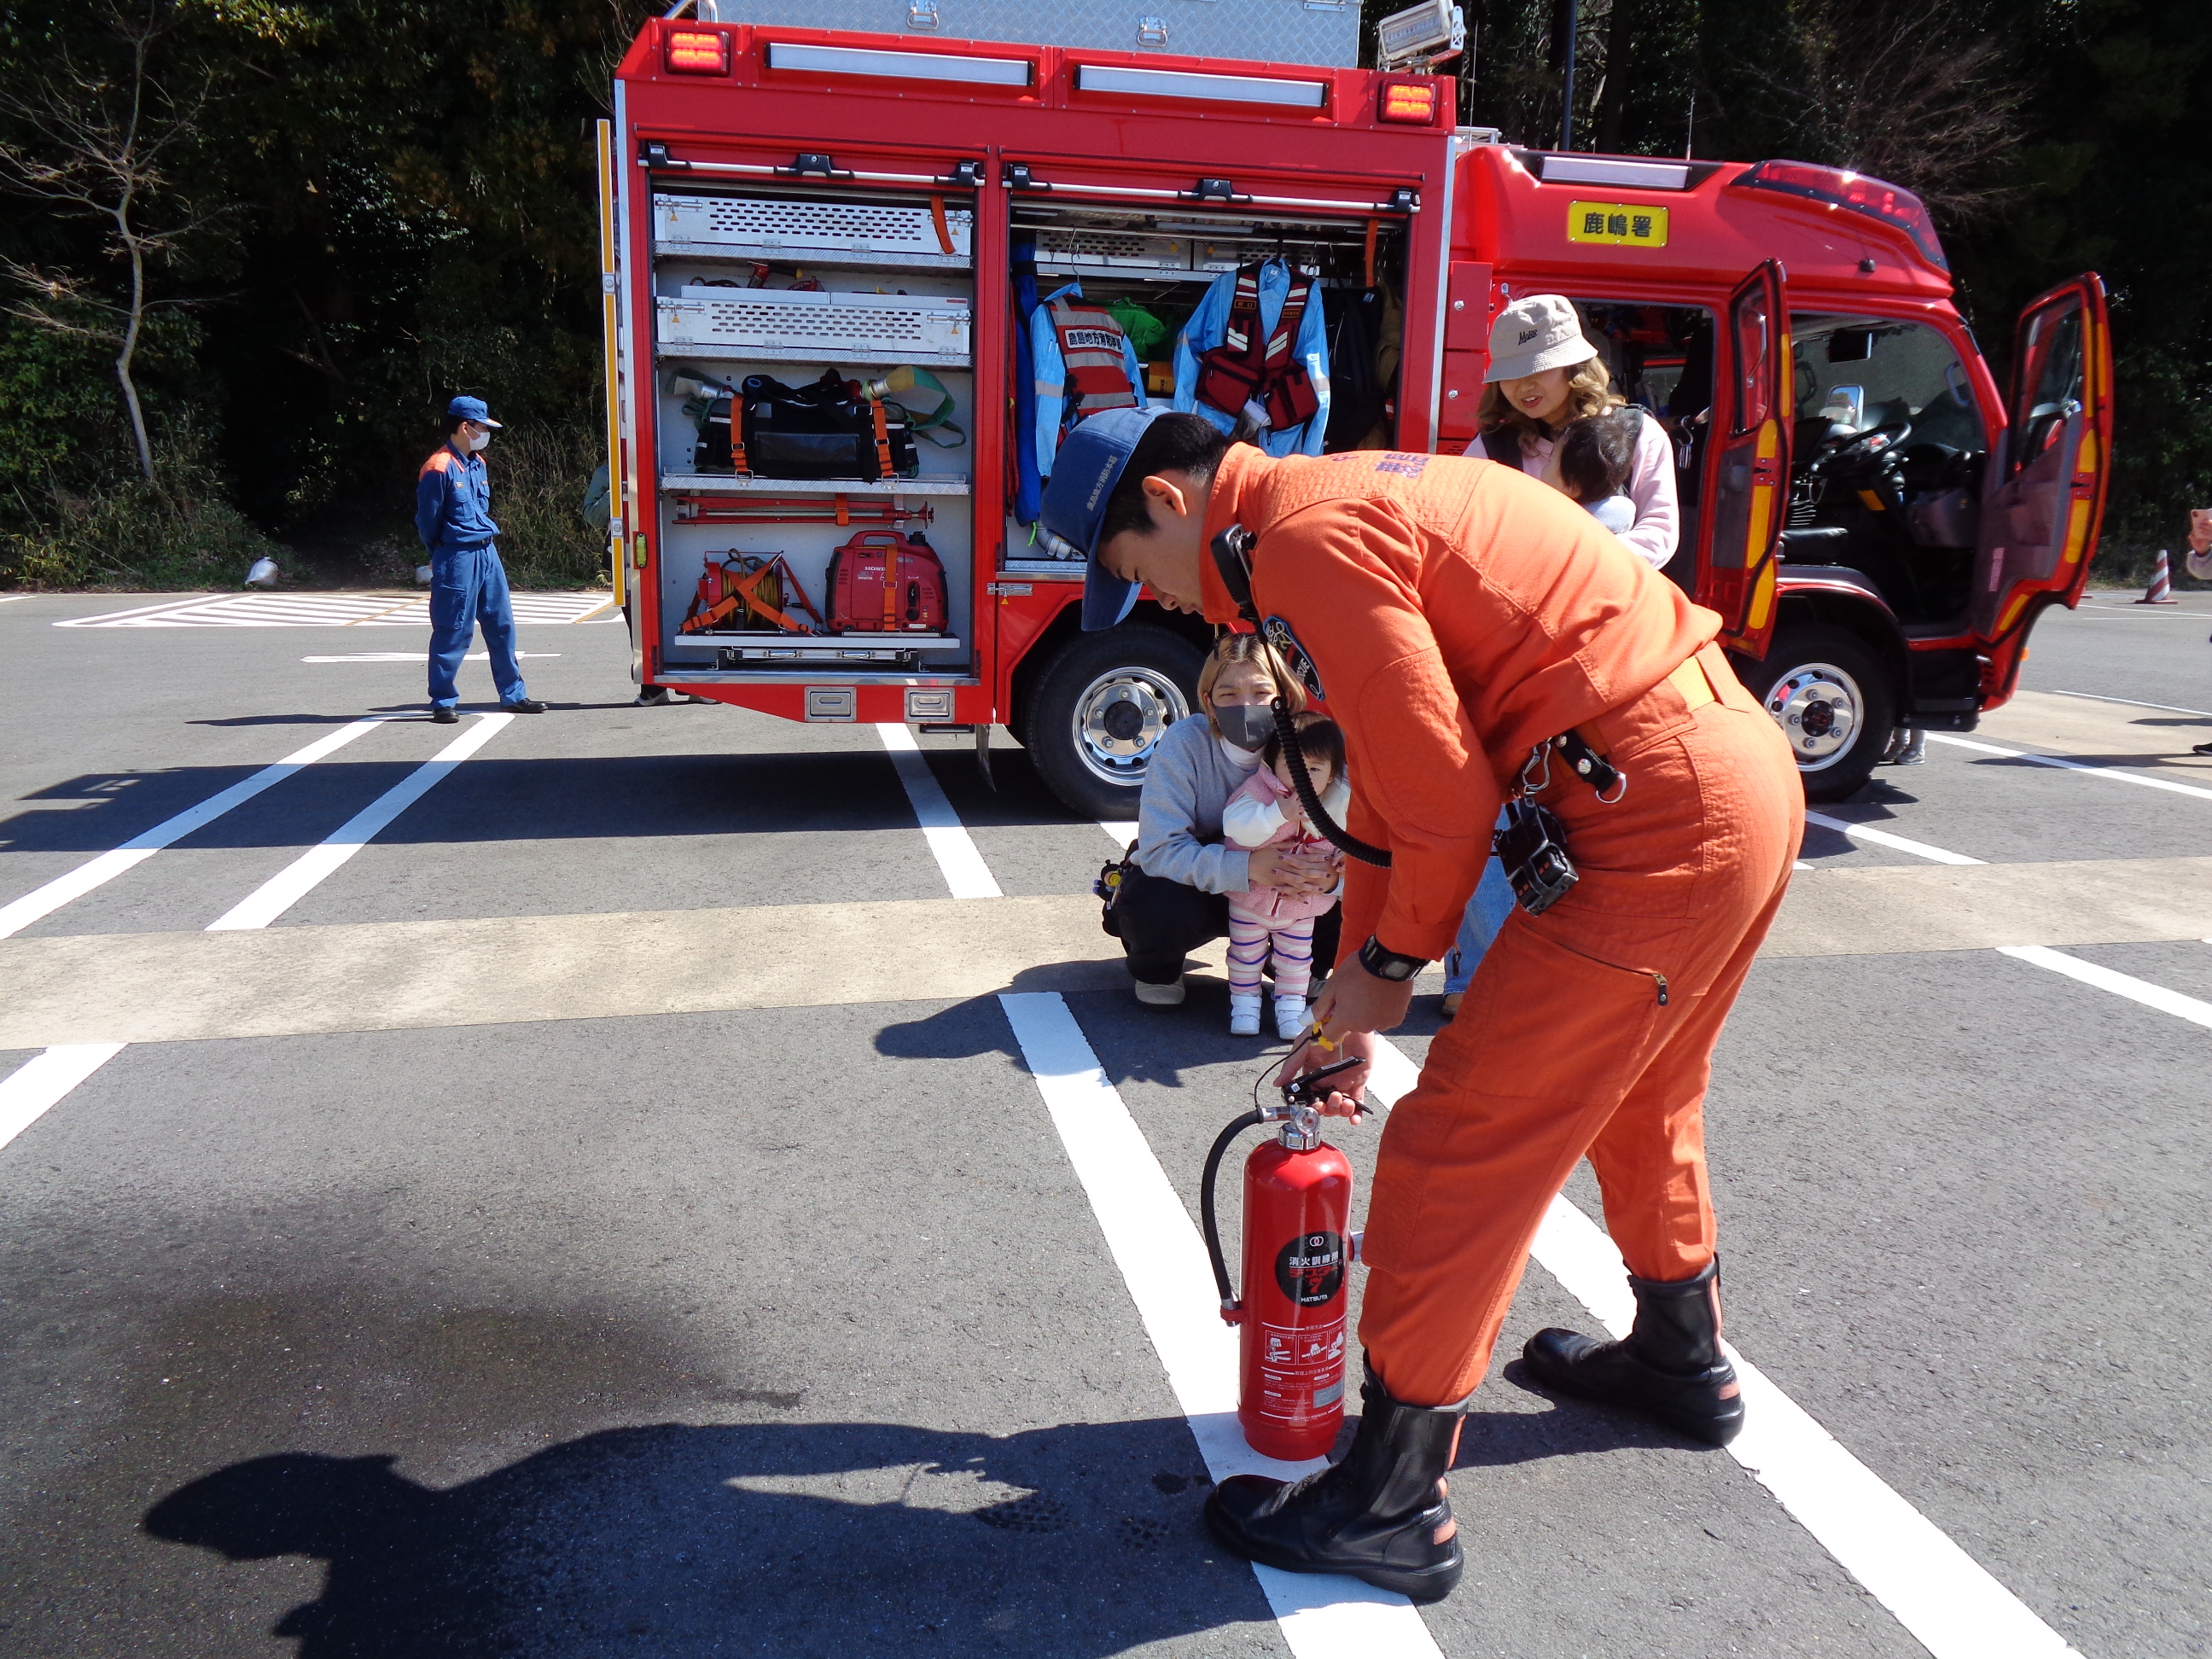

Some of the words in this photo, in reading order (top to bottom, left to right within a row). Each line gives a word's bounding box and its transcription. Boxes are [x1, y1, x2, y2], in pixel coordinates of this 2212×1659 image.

[1584, 212, 1652, 237] 鹿嶋署
[1289, 1251, 1339, 1266] 消火訓練用
